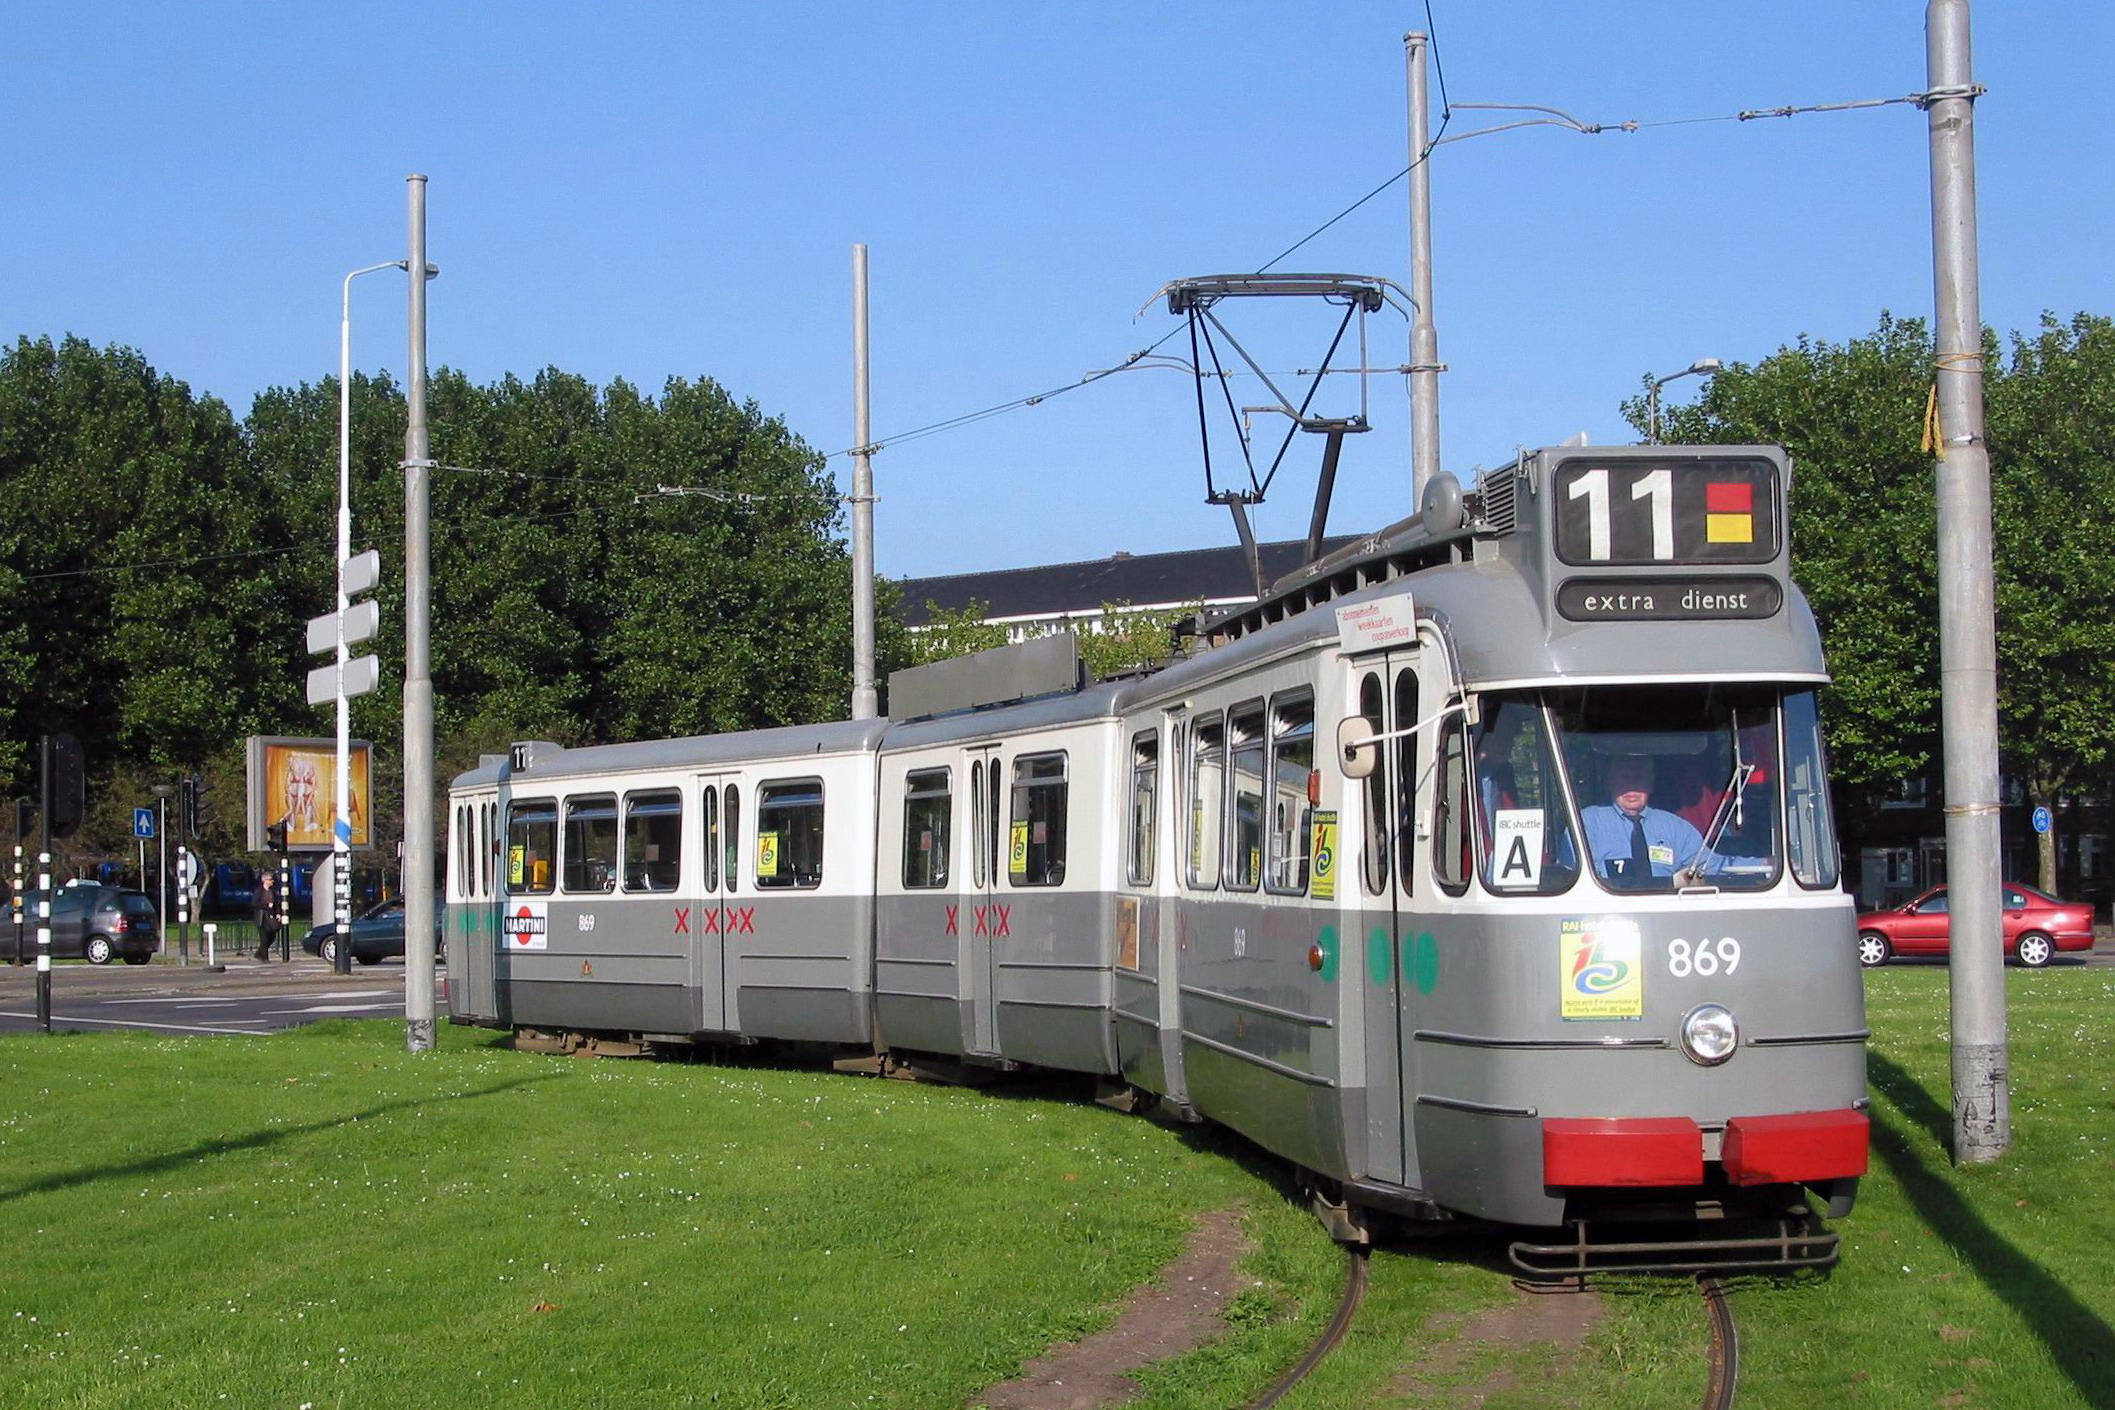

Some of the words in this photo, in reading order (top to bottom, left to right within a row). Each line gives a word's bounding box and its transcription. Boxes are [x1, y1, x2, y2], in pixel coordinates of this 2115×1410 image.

[1568, 469, 1674, 560] 11
[1584, 592, 1654, 611] extra
[1681, 589, 1748, 610] dienst
[1513, 819, 1541, 829] shuttle
[1501, 836, 1532, 878] A
[1614, 860, 1625, 874] 7
[506, 918, 544, 933] MARTINI
[578, 914, 595, 931] 869
[1668, 937, 1741, 978] 869
